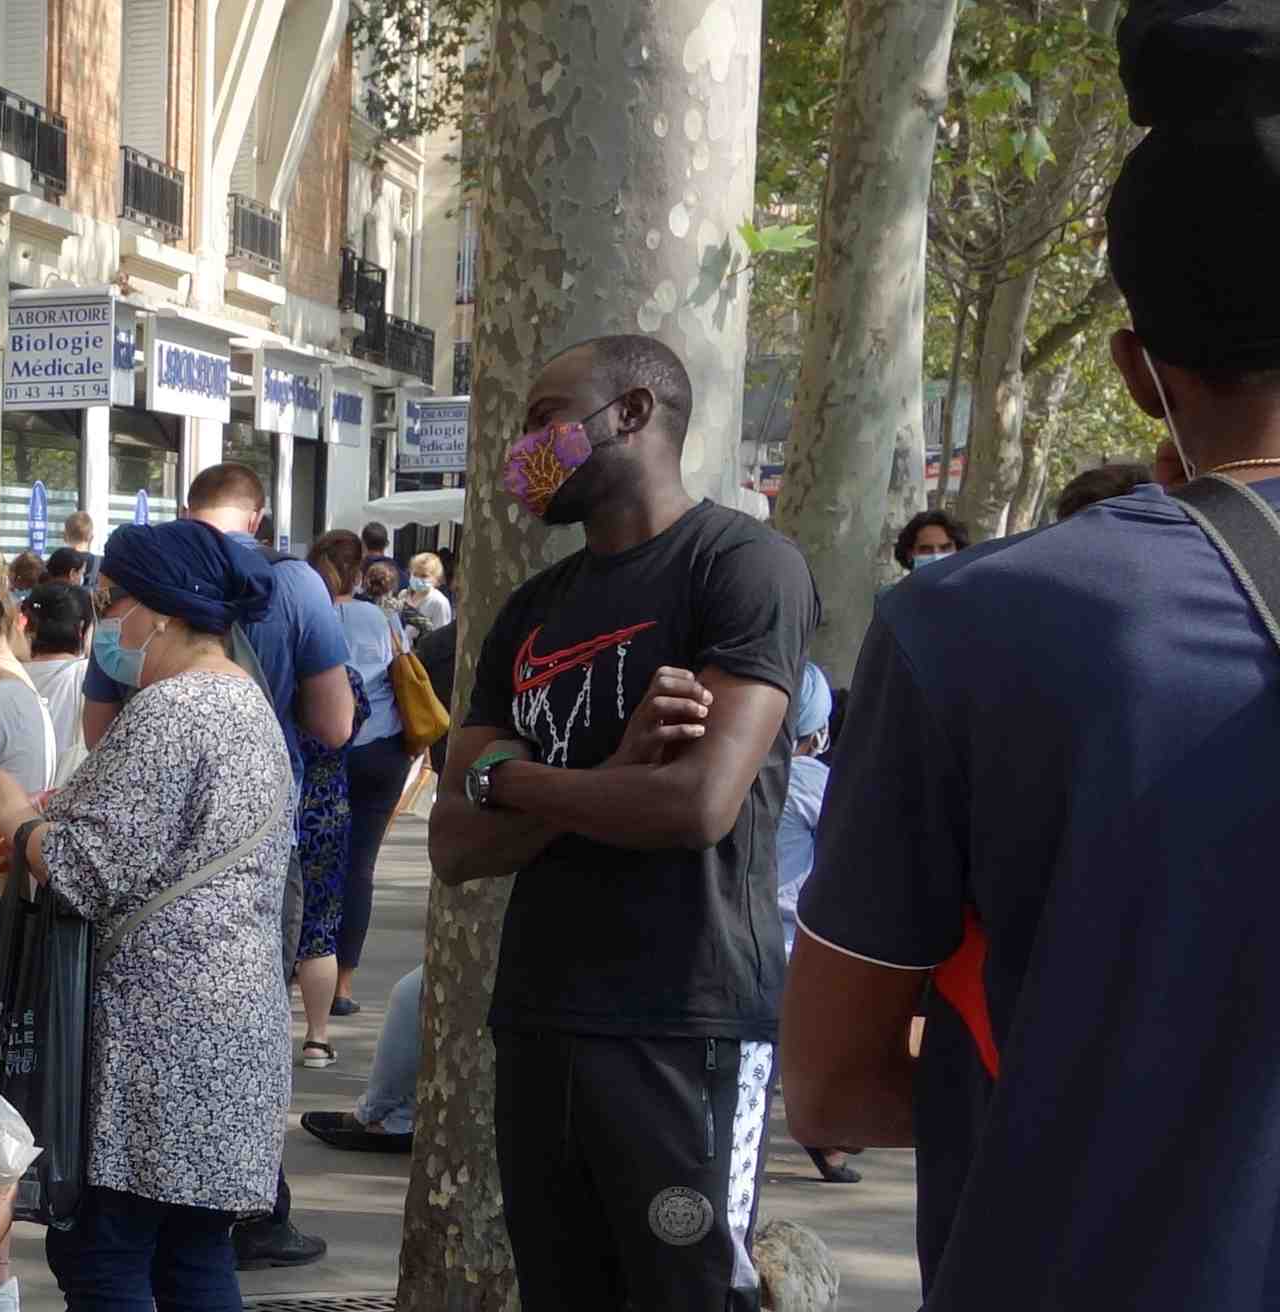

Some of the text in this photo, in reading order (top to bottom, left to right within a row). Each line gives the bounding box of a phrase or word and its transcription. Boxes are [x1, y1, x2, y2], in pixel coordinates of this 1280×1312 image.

[8, 307, 109, 326] LABORATOIRE
[11, 331, 104, 355] Biologie
[10, 357, 104, 378] Médicale
[4, 383, 108, 400] 01 43 44 51 94
